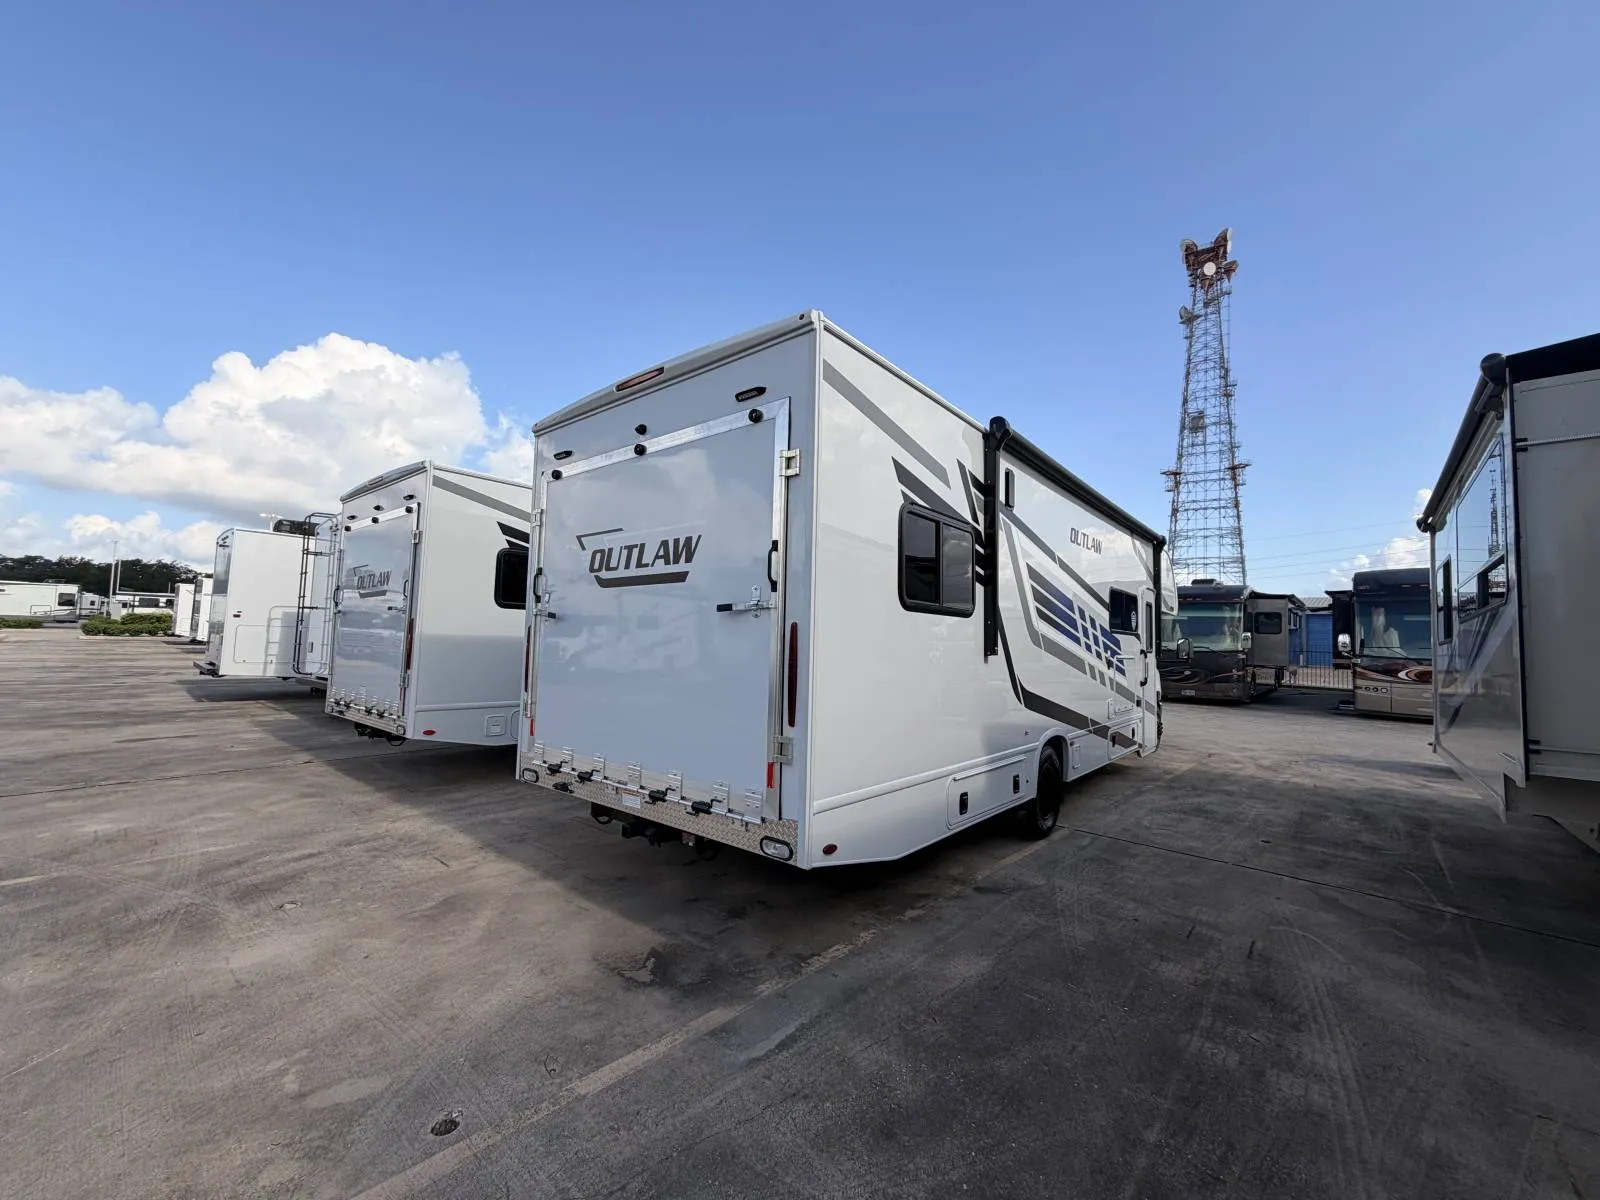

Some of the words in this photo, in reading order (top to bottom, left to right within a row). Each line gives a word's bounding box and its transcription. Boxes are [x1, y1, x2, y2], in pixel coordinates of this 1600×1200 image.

[588, 534, 702, 573] OUTLAW
[1070, 527, 1102, 555] OUTLAW
[357, 570, 392, 590] OUTLAW
